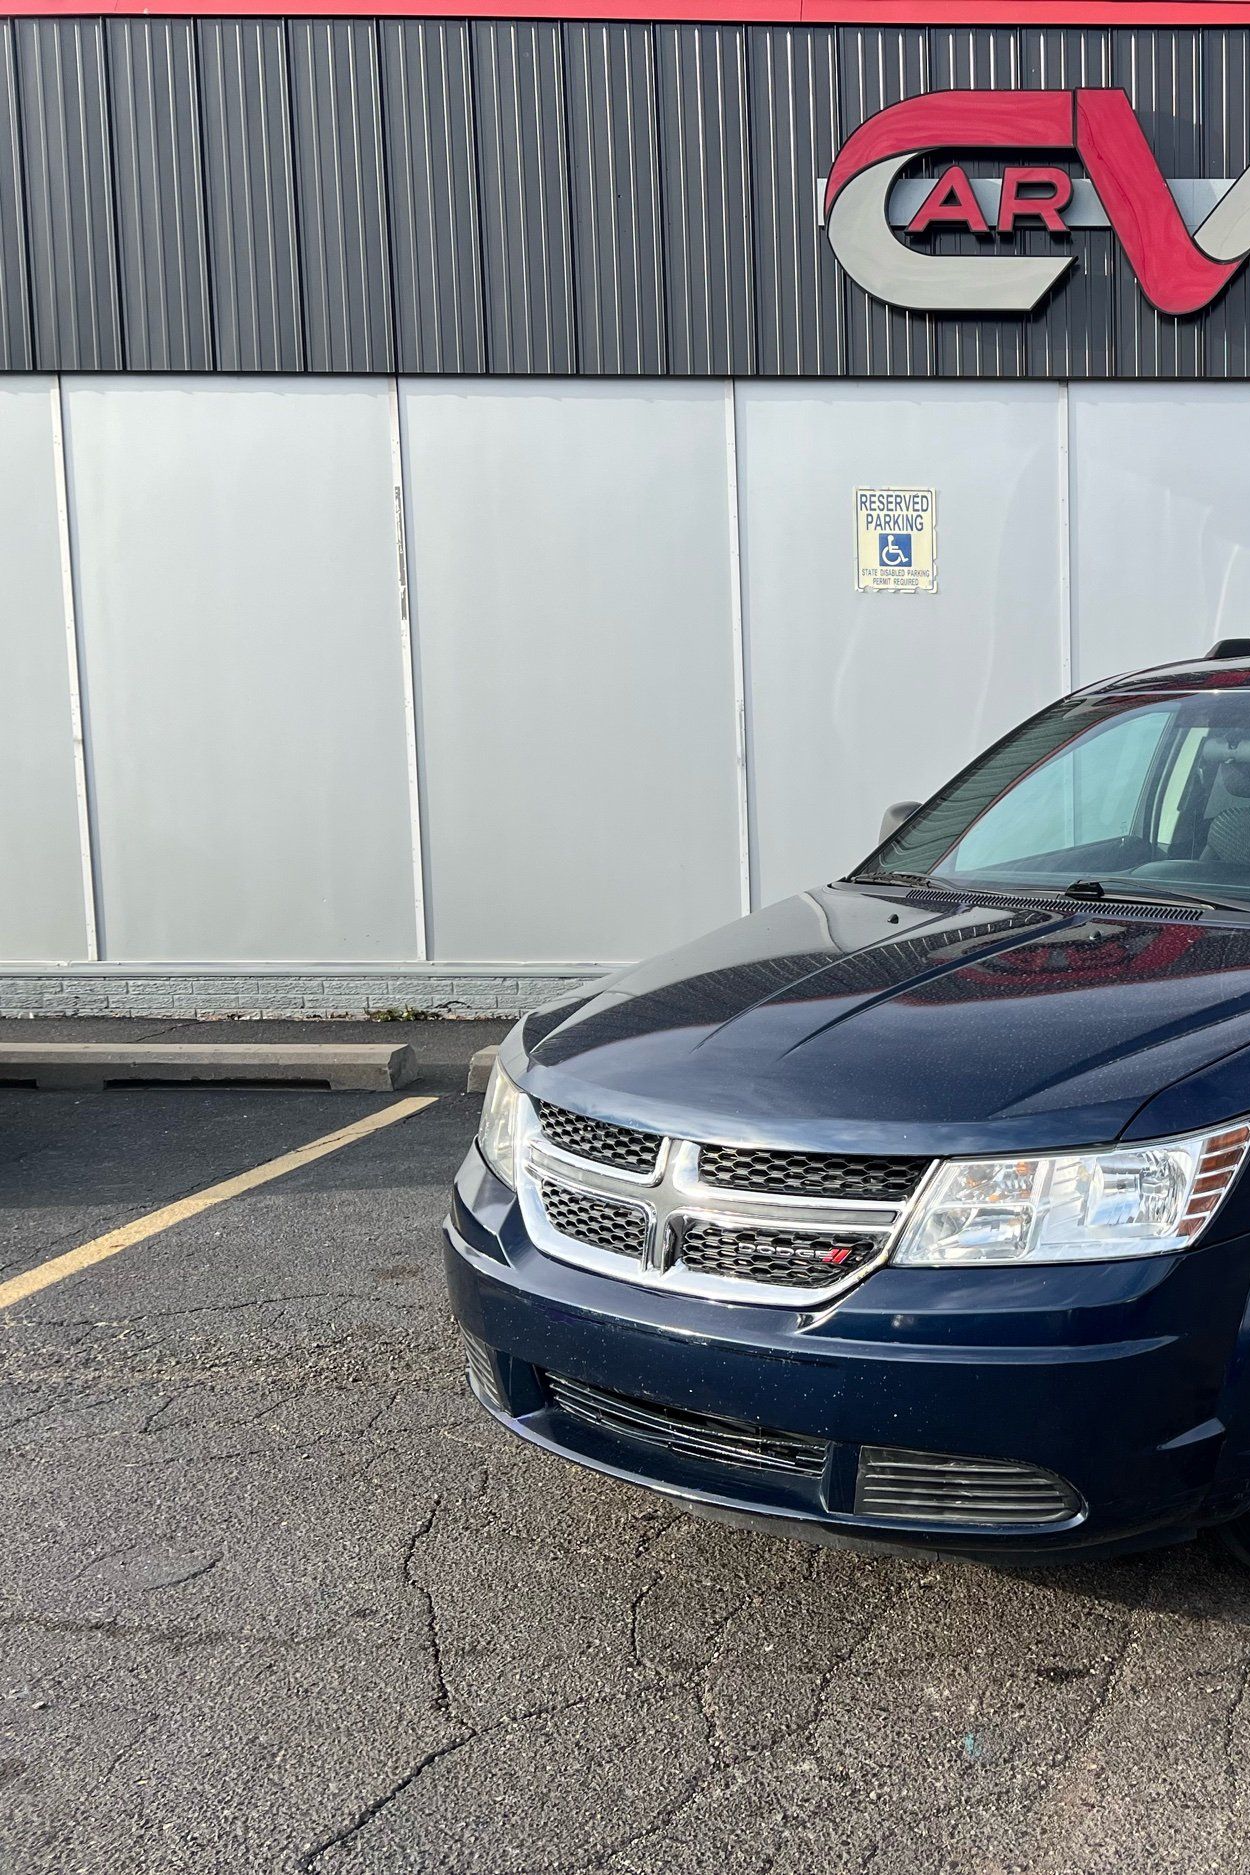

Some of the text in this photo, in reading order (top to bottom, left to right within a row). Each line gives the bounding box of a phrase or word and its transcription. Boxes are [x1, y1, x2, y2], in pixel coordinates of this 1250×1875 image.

[860, 493, 929, 513] RESERVED
[866, 513, 924, 532] PARKING
[862, 568, 878, 577] STATE
[907, 569, 930, 578] PARKING
[738, 1242, 835, 1262] DODGE
